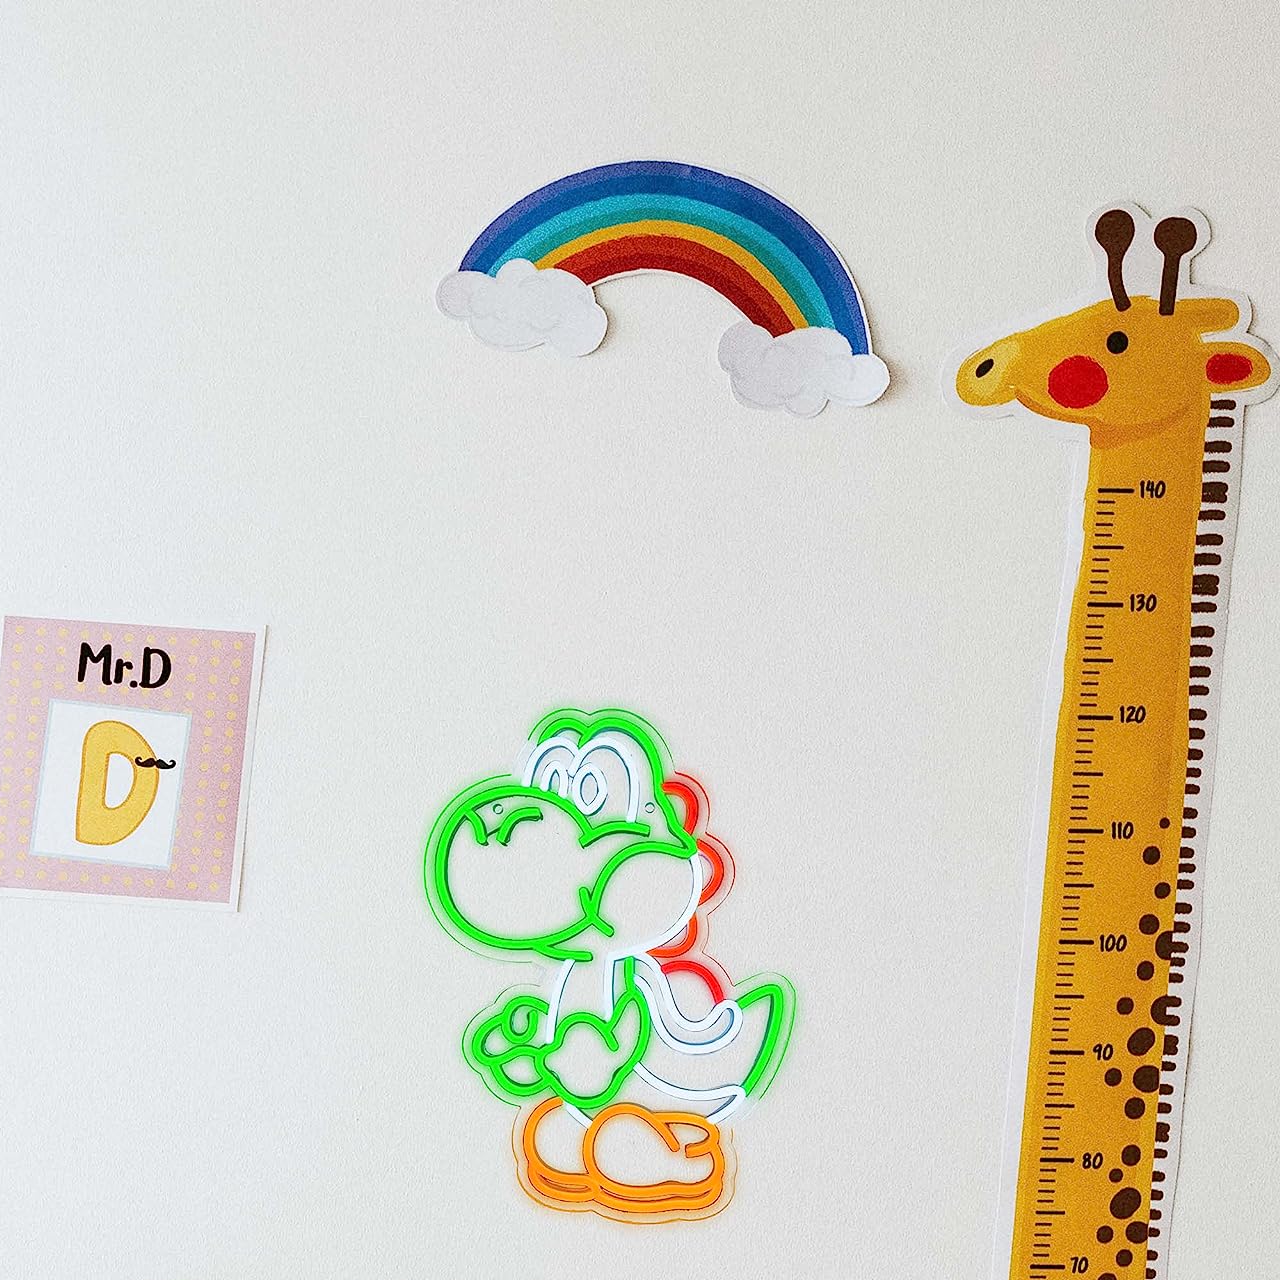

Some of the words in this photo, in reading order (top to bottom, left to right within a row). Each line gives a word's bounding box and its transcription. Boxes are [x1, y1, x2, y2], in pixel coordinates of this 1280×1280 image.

[1140, 480, 1166, 499] 140
[1129, 593, 1157, 612] 130
[78, 643, 171, 689] Mr.D
[1119, 705, 1146, 724] 120
[76, 720, 160, 846] D
[1111, 821, 1134, 840] 110
[1099, 933, 1128, 952] 100
[1092, 1043, 1114, 1061] 90
[1081, 1152, 1104, 1170] 80
[1070, 1256, 1089, 1274] 70
